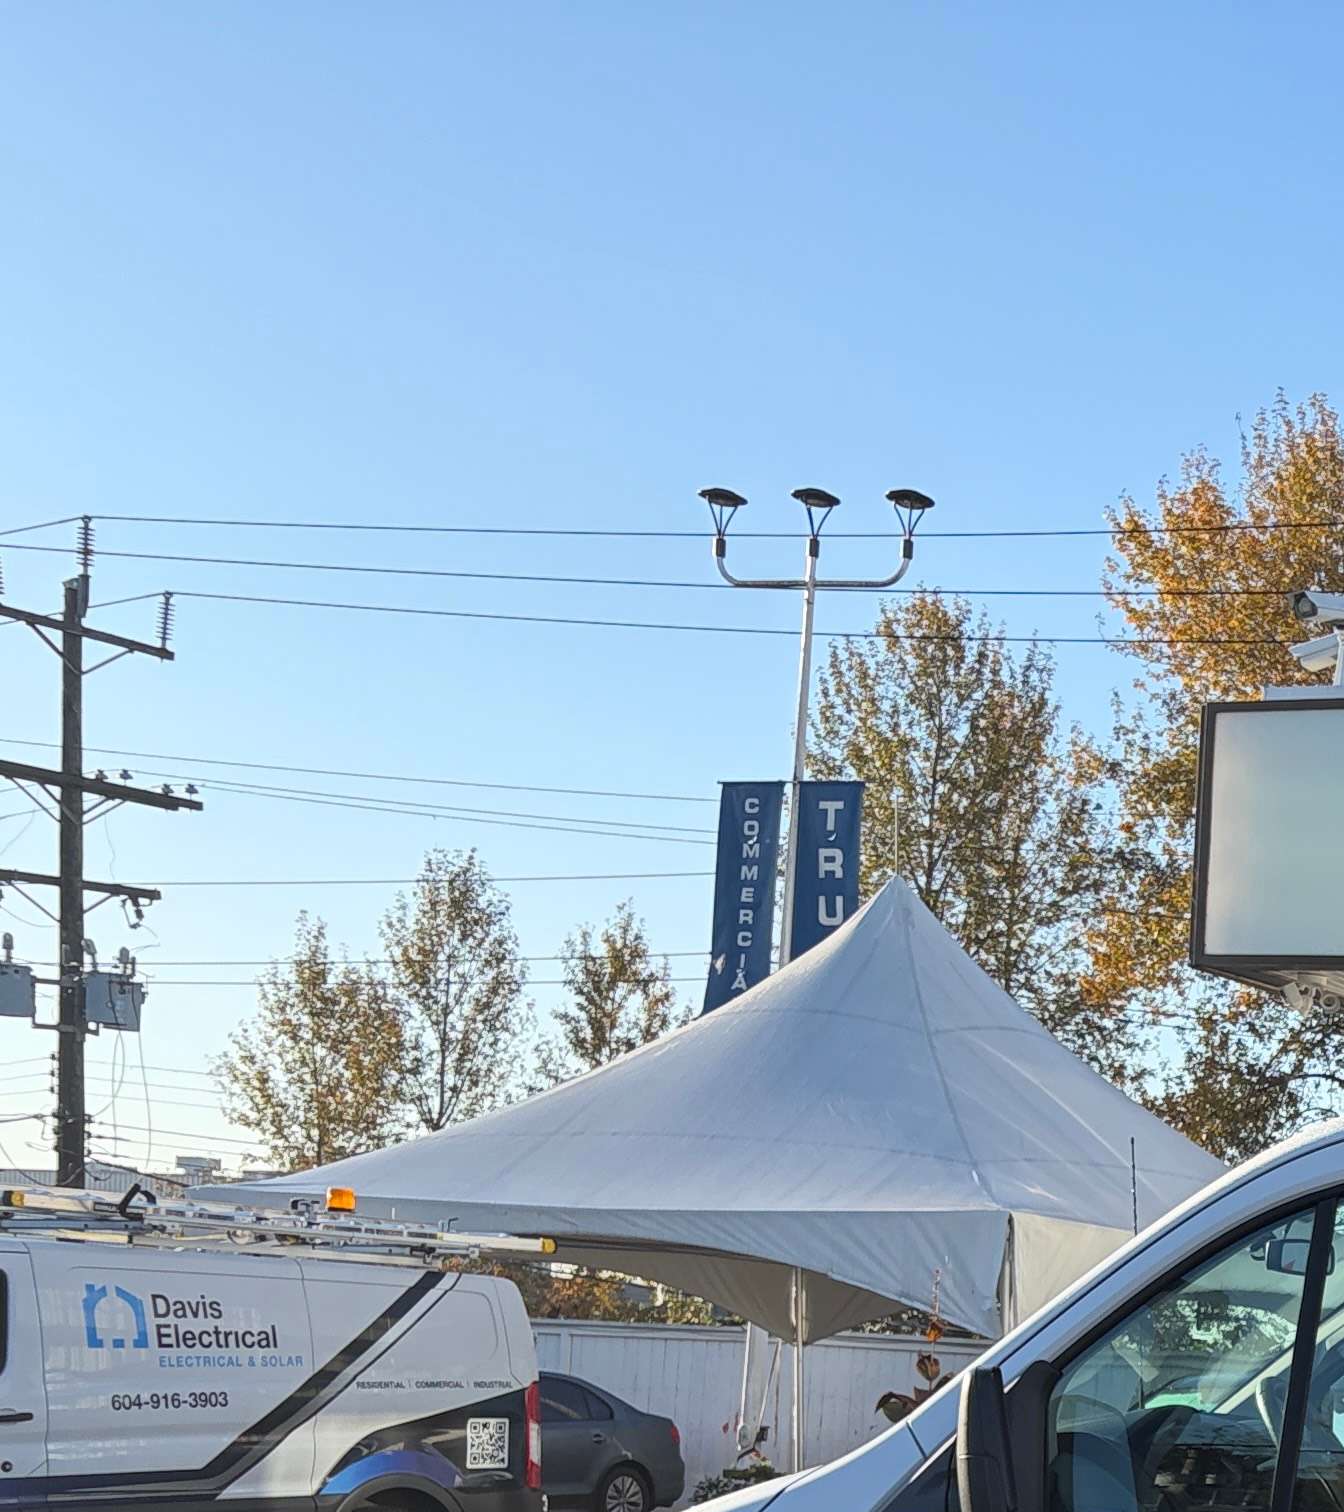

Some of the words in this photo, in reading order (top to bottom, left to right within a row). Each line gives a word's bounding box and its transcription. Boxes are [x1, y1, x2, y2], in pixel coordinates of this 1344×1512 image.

[150, 1294, 223, 1319] Davis
[155, 1324, 278, 1349] Electrical
[159, 1355, 242, 1368] ELECTRICAL
[247, 1355, 257, 1368] &
[260, 1355, 304, 1368] SOLAR
[356, 1380, 406, 1390] RESIDENTIAL
[415, 1380, 465, 1390] COMMERCIAL
[473, 1380, 513, 1390] INDUSTRIAL
[111, 1391, 229, 1411] 604-916-3903
